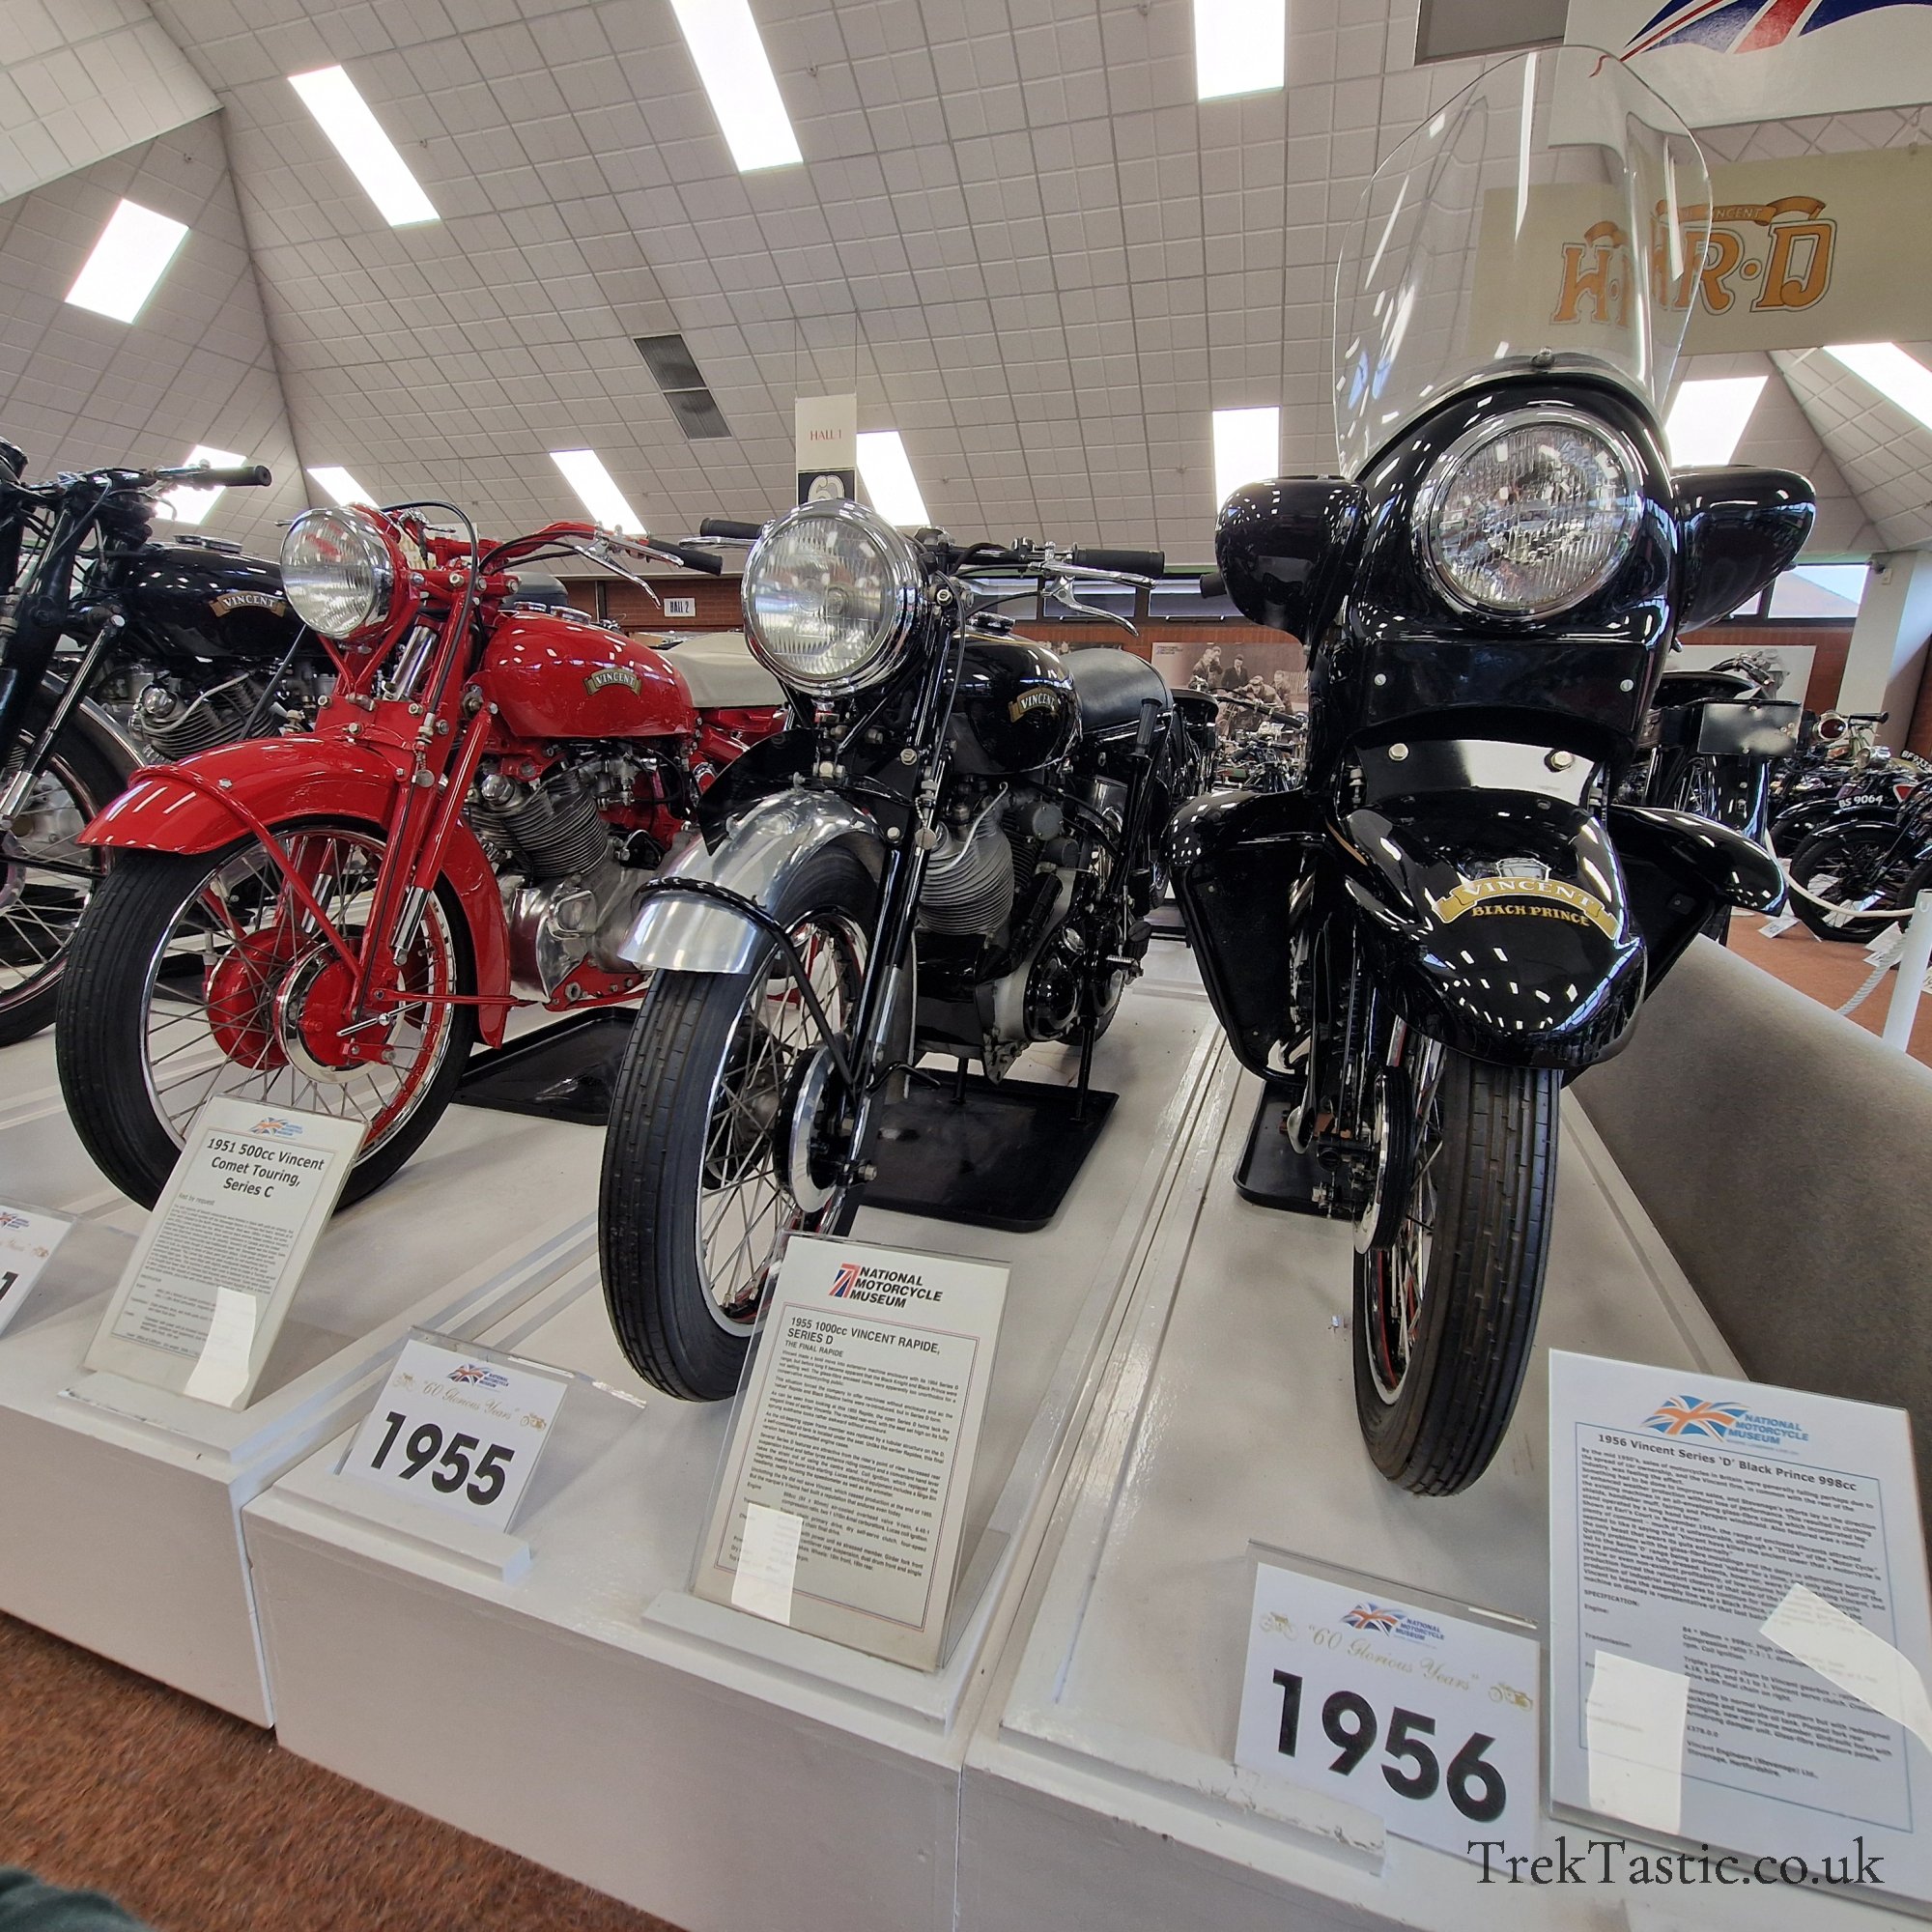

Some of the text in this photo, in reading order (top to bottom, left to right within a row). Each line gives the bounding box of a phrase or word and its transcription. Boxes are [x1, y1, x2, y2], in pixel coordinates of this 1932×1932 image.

[810, 429, 835, 440] HALL
[223, 594, 275, 608] VINCENT
[670, 601, 690, 612] HALL 2
[594, 671, 636, 687] VINCENT
[1020, 693, 1055, 711] VINCENT
[1838, 795, 1883, 808] BS 9064
[1463, 880, 1594, 906] VINCENT
[1471, 904, 1590, 927] BLACK PRINCE
[207, 1137, 326, 1172] 1951 500cc Vincent
[211, 1156, 300, 1187] Comet Touring,
[223, 1178, 274, 1198] Series C
[859, 1266, 923, 1286] NATIONAL
[849, 1290, 906, 1308] MUSEUM
[855, 1278, 943, 1302] MOTORCYCLE
[787, 1327, 834, 1345] SERIES D
[791, 1317, 940, 1354] 1955 1000cc VINCENT RAPIDE,
[784, 1340, 843, 1357] THE FINAL RAPIDE
[442, 1389, 481, 1410] Glorious
[1735, 1421, 1809, 1442] MOTORCYCLE
[1745, 1414, 1803, 1432] NATIONAL
[1728, 1429, 1780, 1445] MUSEUM
[371, 1411, 515, 1506] 1955
[1598, 1434, 1627, 1447] 1956
[1630, 1439, 1675, 1456] Vincent
[1677, 1448, 1716, 1463] Series
[1738, 1460, 1772, 1474] Black
[1775, 1466, 1815, 1483] Prince
[1817, 1475, 1857, 1491] 998cc
[1395, 1628, 1425, 1640] MUSEUM
[1401, 1623, 1445, 1640] MOTORCYCLE
[1406, 1618, 1440, 1633] NATIONAL
[1347, 1640, 1413, 1673] Glorious
[1273, 1668, 1506, 1823] 1956
